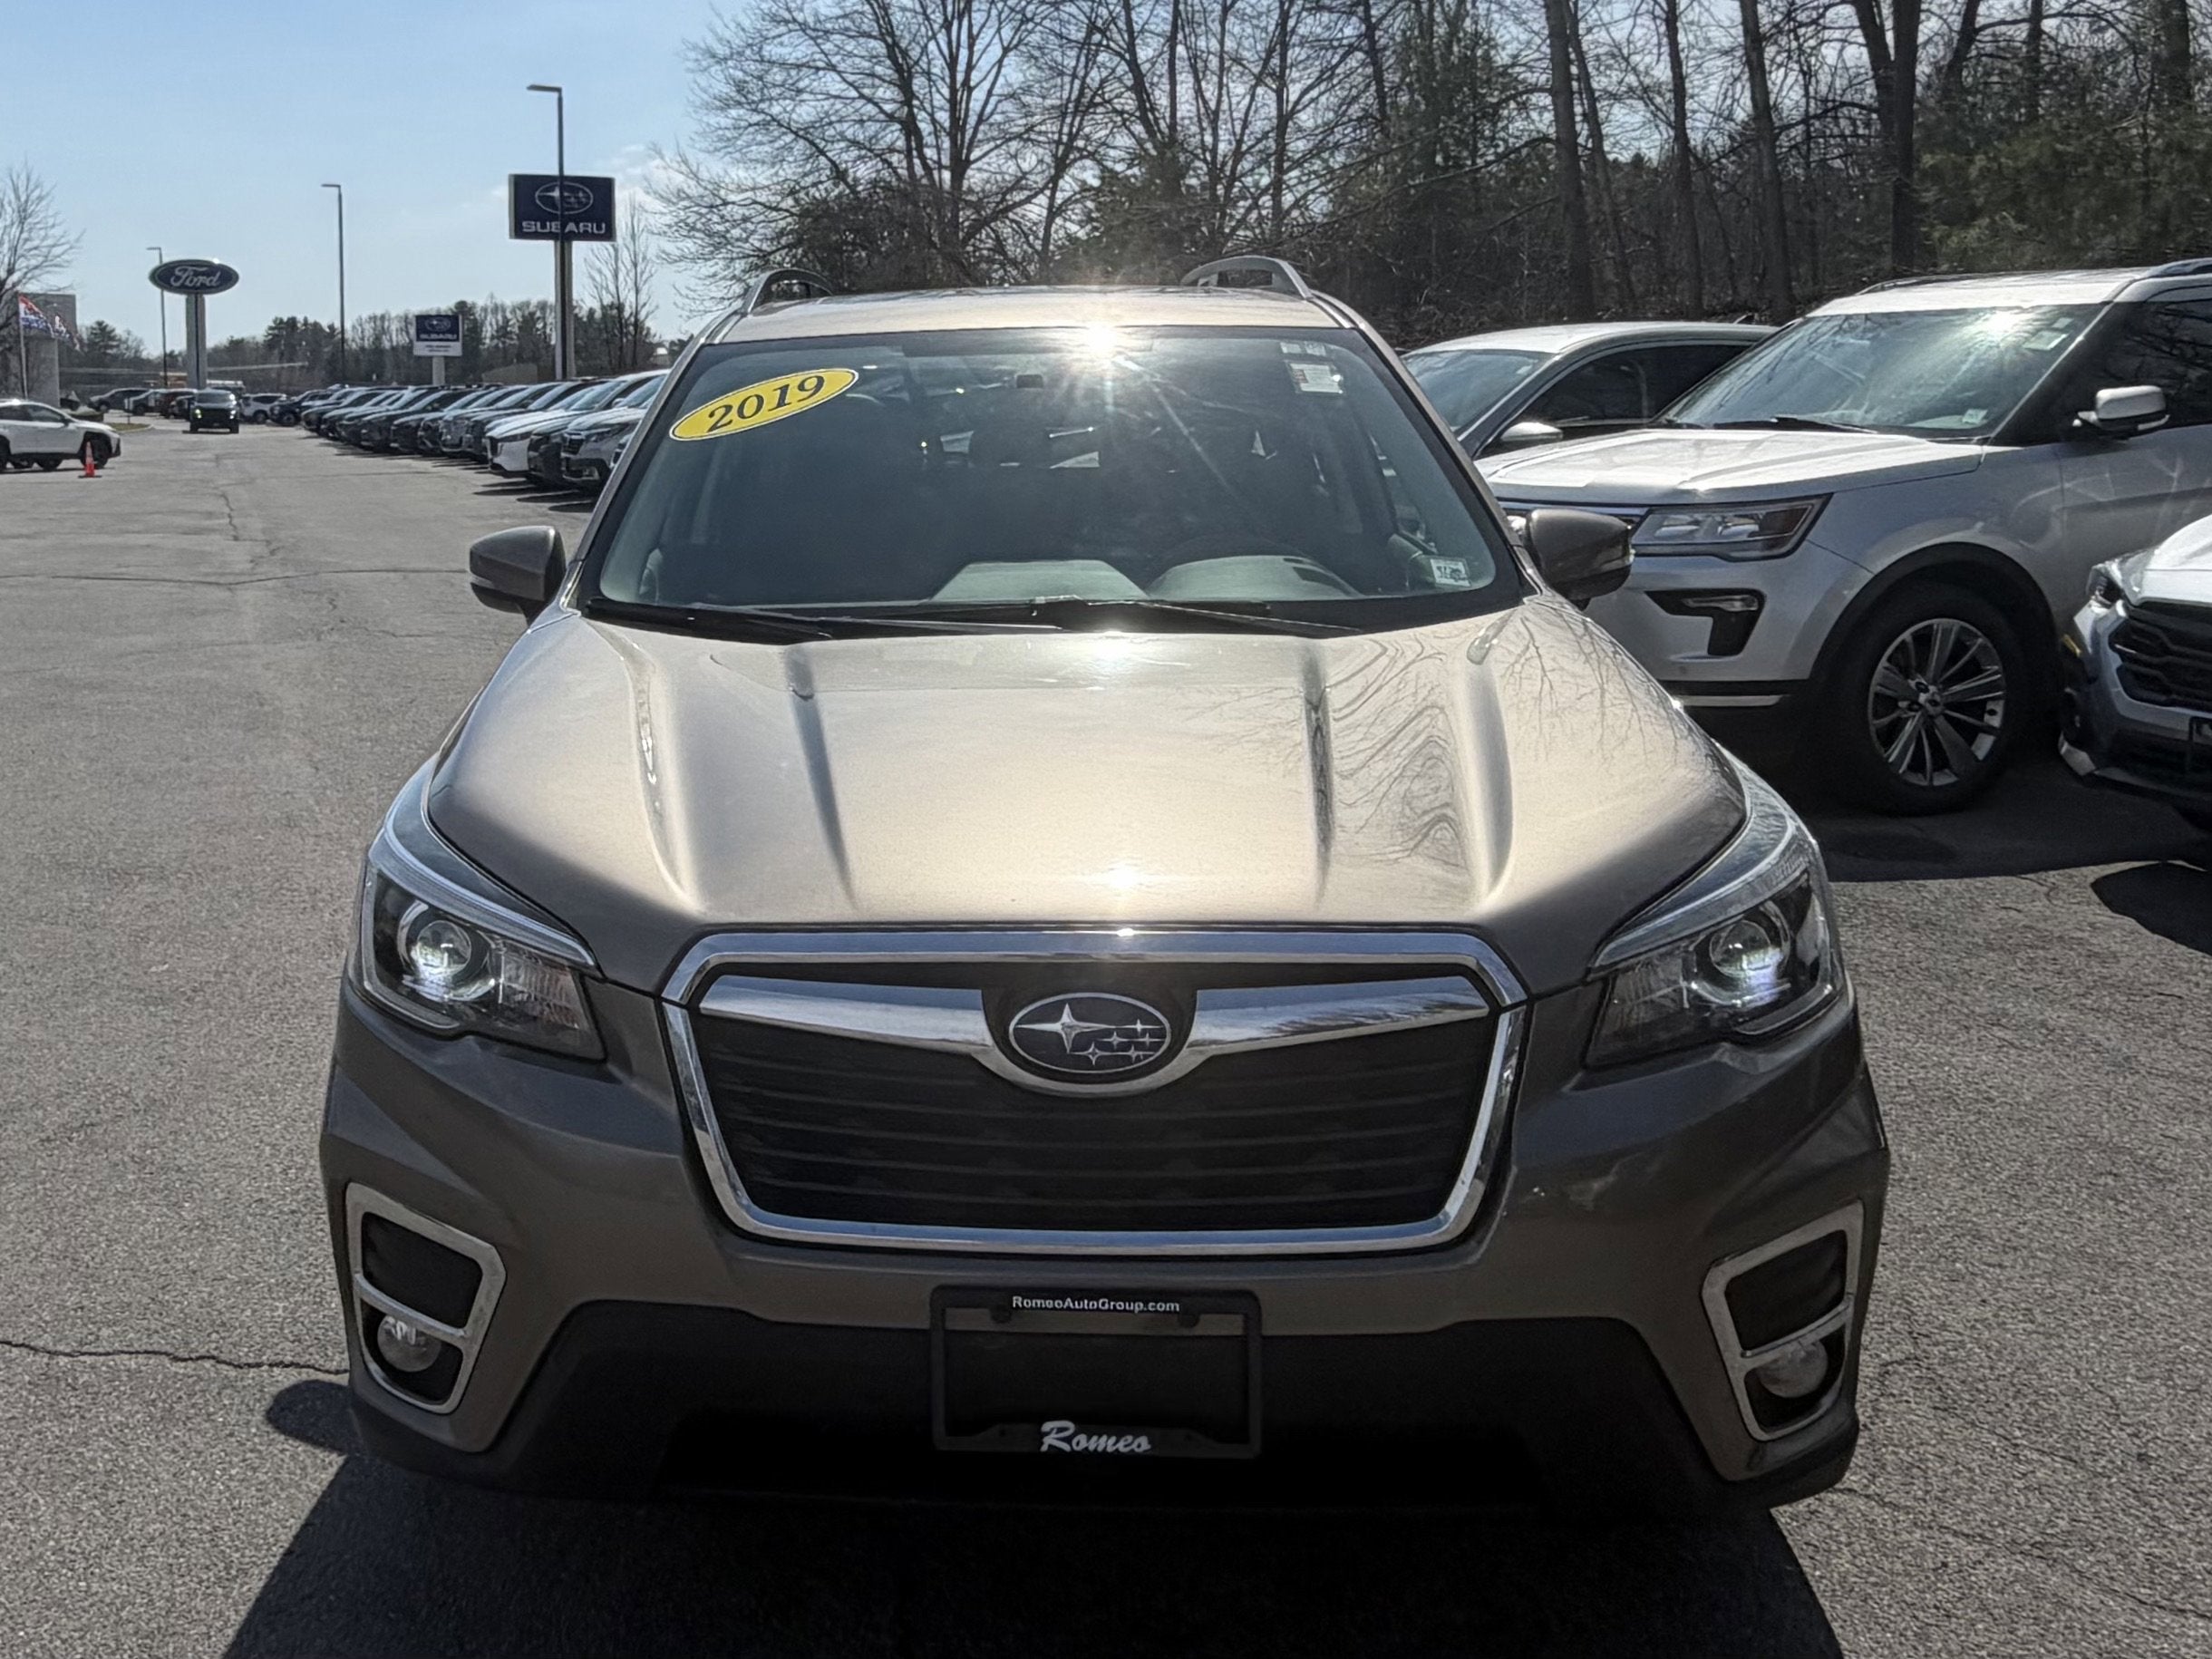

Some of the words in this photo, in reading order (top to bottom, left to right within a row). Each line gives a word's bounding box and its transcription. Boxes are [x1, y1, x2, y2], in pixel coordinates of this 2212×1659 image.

[521, 220, 606, 234] SUBARU
[170, 266, 221, 287] Ford
[706, 374, 825, 433] 2019
[1012, 1295, 1180, 1314] RomeoAutoGroup.com
[1039, 1420, 1152, 1452] Romeo
